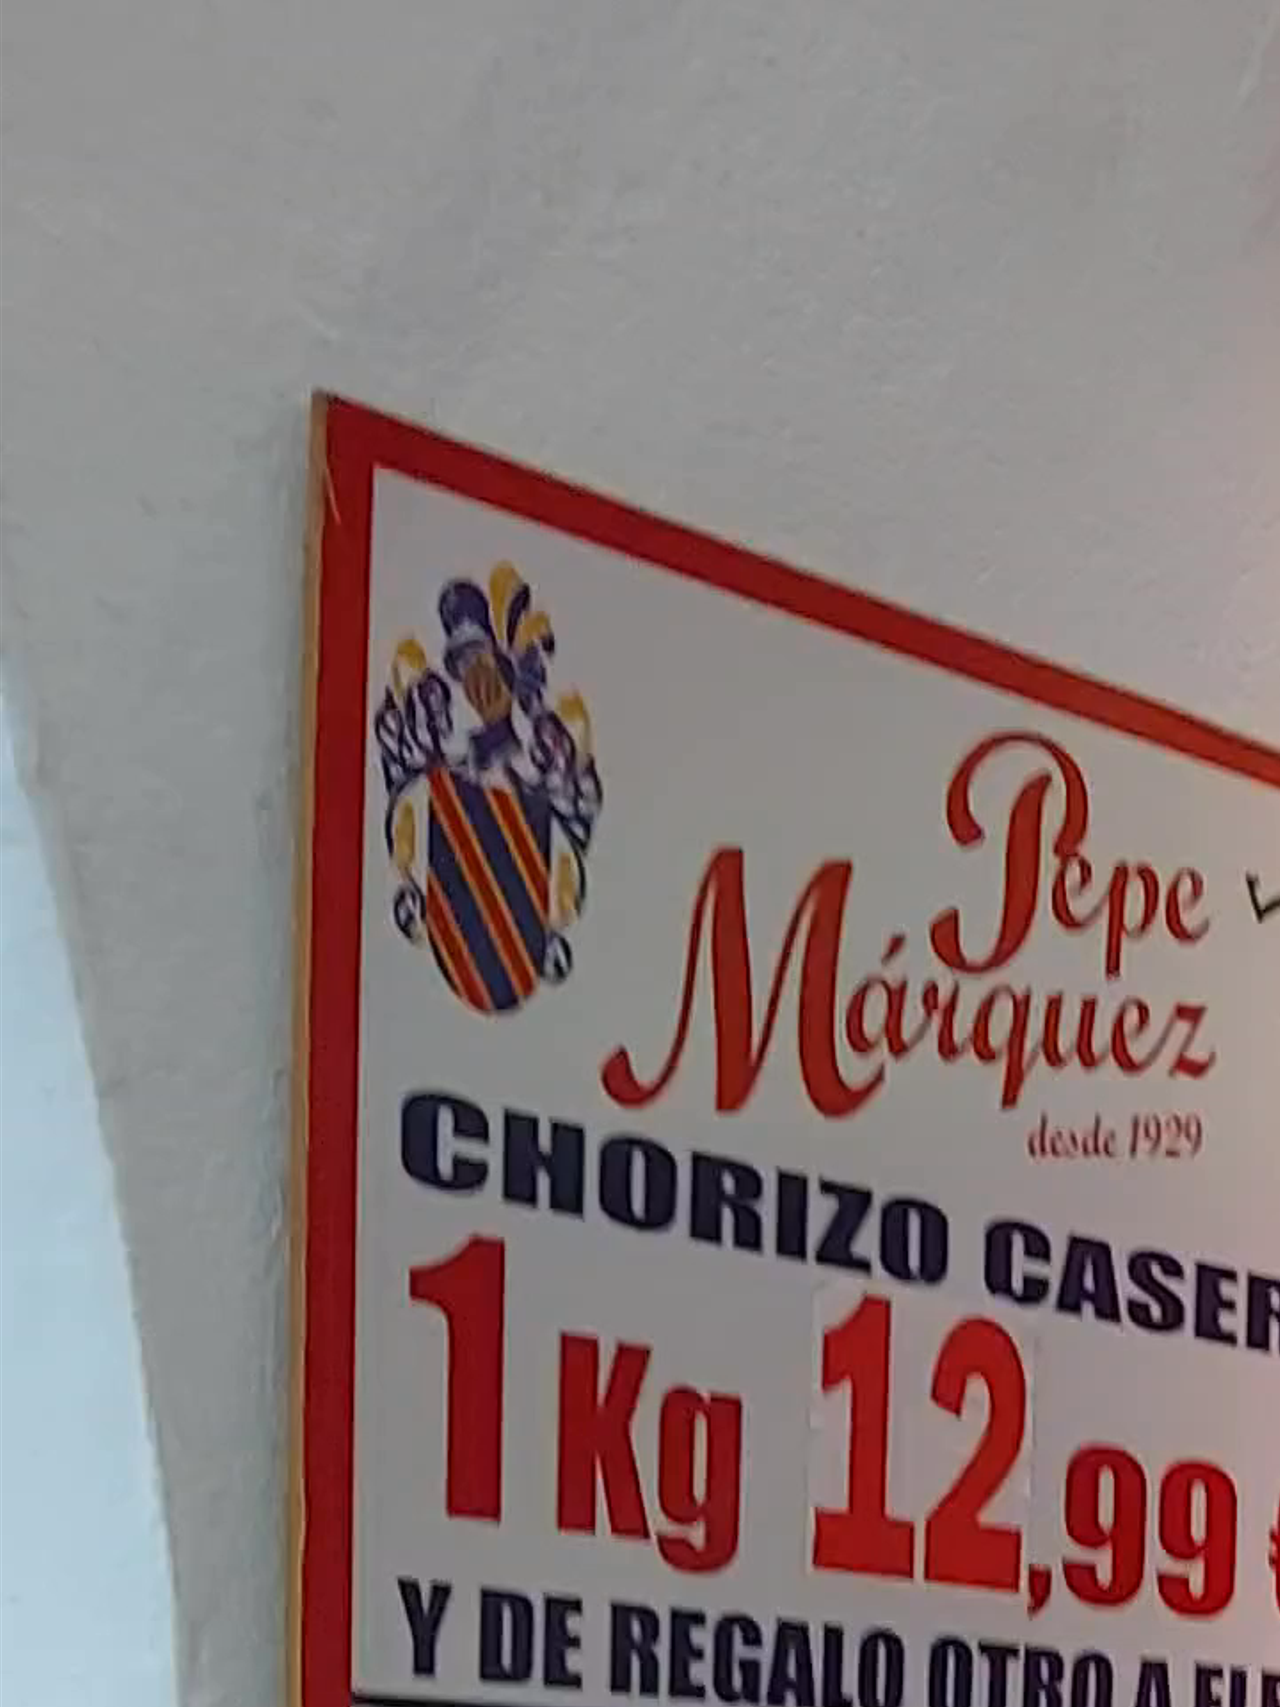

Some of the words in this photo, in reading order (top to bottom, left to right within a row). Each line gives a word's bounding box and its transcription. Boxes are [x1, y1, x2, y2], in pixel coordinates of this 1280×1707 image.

[928, 730, 1213, 981] Pepe
[600, 845, 1218, 1120] Márquez
[400, 1091, 949, 1286] CHORIZO
[1026, 1110, 1117, 1162] desde
[1125, 1108, 1203, 1161] 1929
[409, 1233, 505, 1522] 1
[556, 1327, 743, 1574] Kg
[397, 1576, 453, 1677] Y
[479, 1586, 583, 1692] DE
